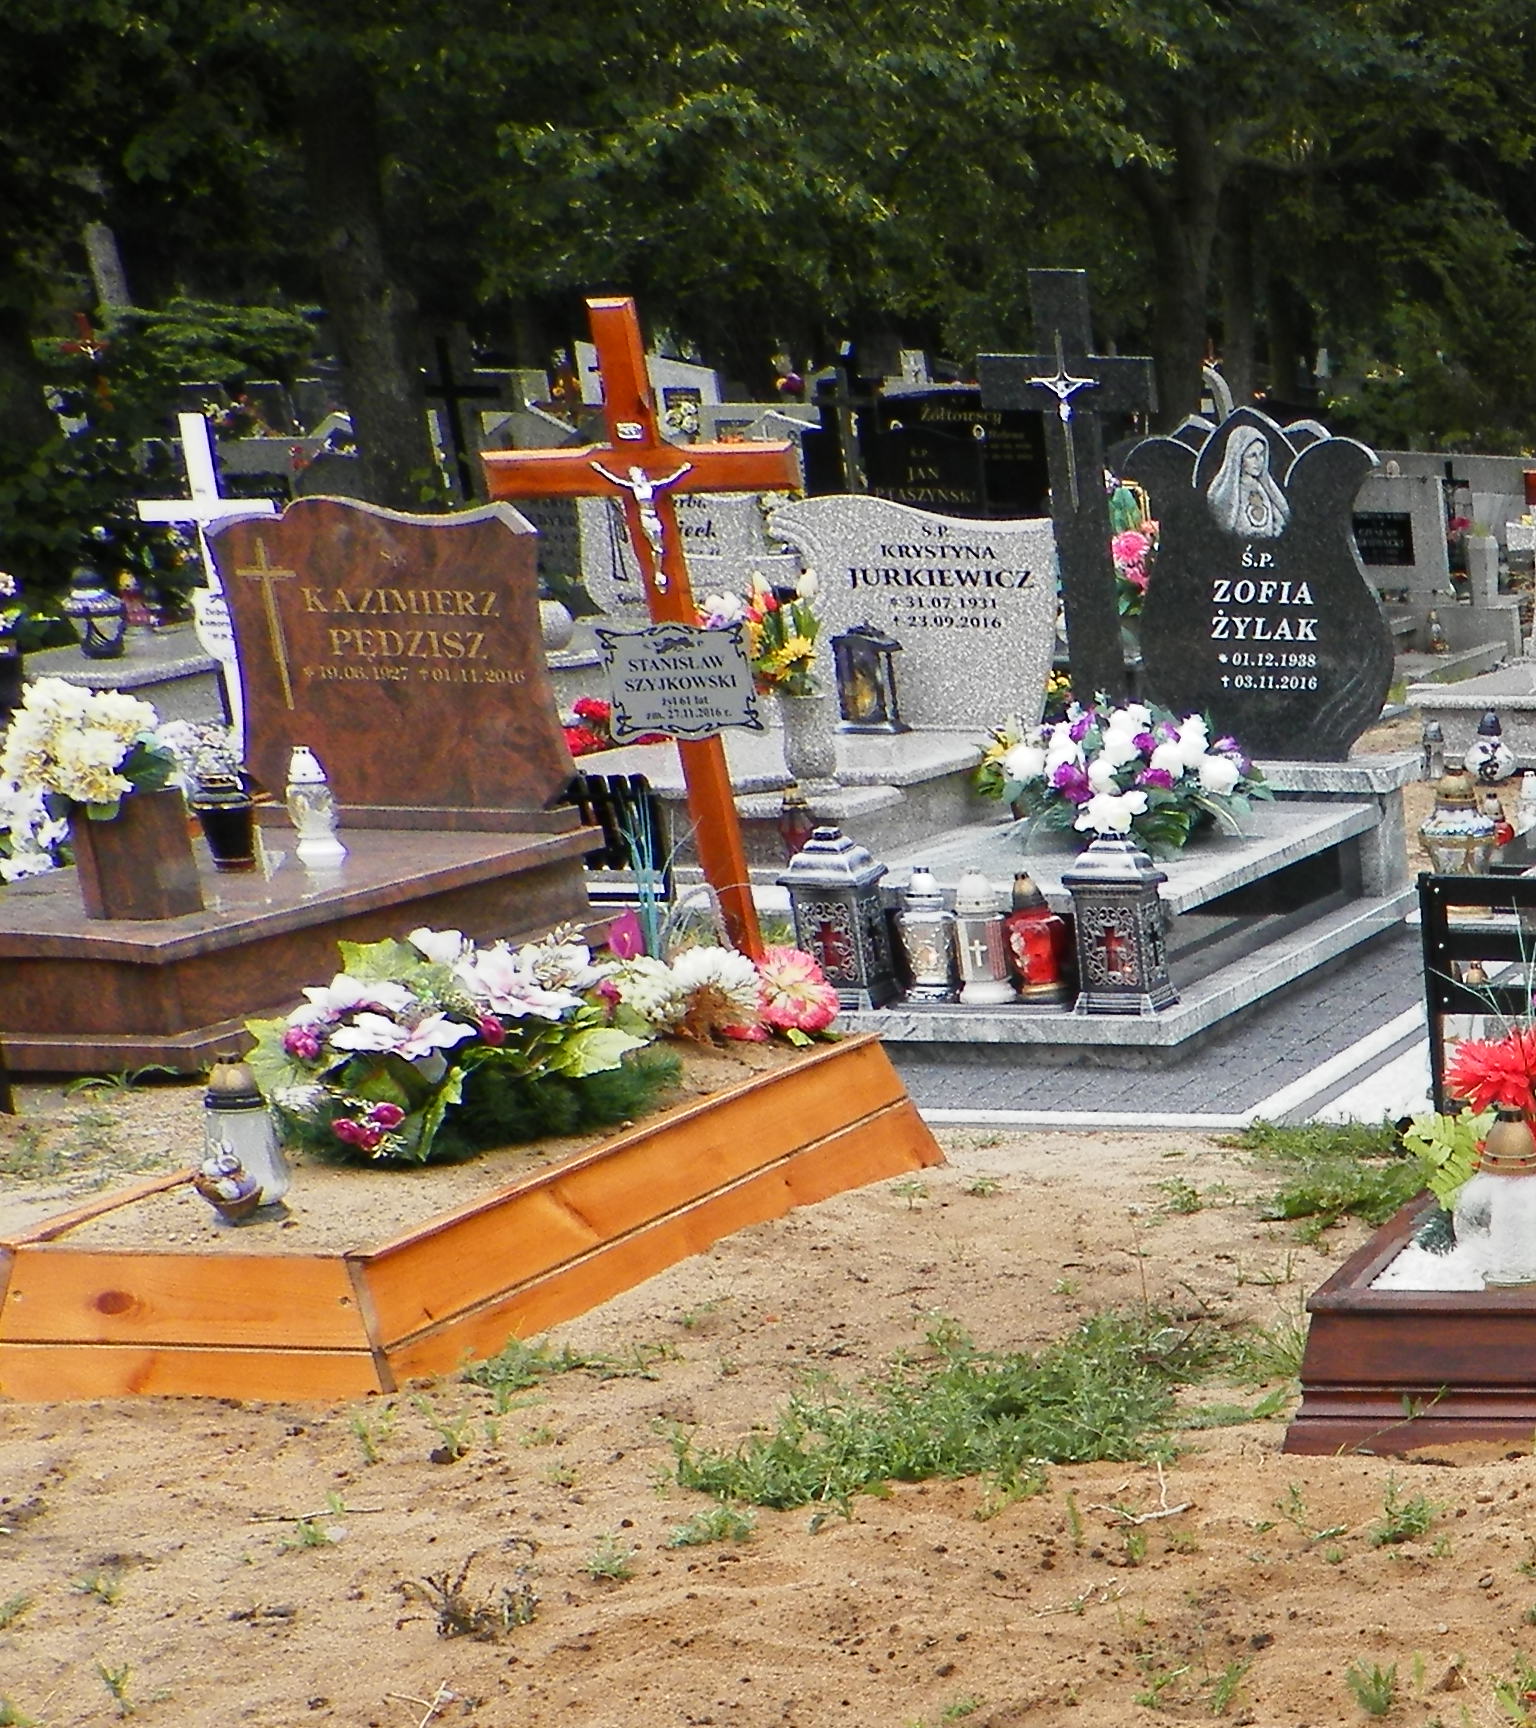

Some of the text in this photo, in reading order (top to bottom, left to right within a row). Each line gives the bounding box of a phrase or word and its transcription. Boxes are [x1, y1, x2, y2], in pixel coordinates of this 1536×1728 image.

[881, 544, 997, 560] KRYSTYNA
[848, 568, 1035, 589] JURKIEWICZ
[1212, 579, 1314, 605] ZOFIA
[300, 587, 500, 617] KAZIMIERZ
[908, 616, 1002, 628] 23.09.2016
[1211, 609, 1318, 641] ŻYLAK
[328, 629, 489, 662] PĘDZISZ
[628, 655, 726, 673] STANISŁAW
[1232, 652, 1317, 667] 01.12.1938
[625, 674, 738, 692] SZYJKOWSKI
[1234, 675, 1318, 690] 03.11.2016
